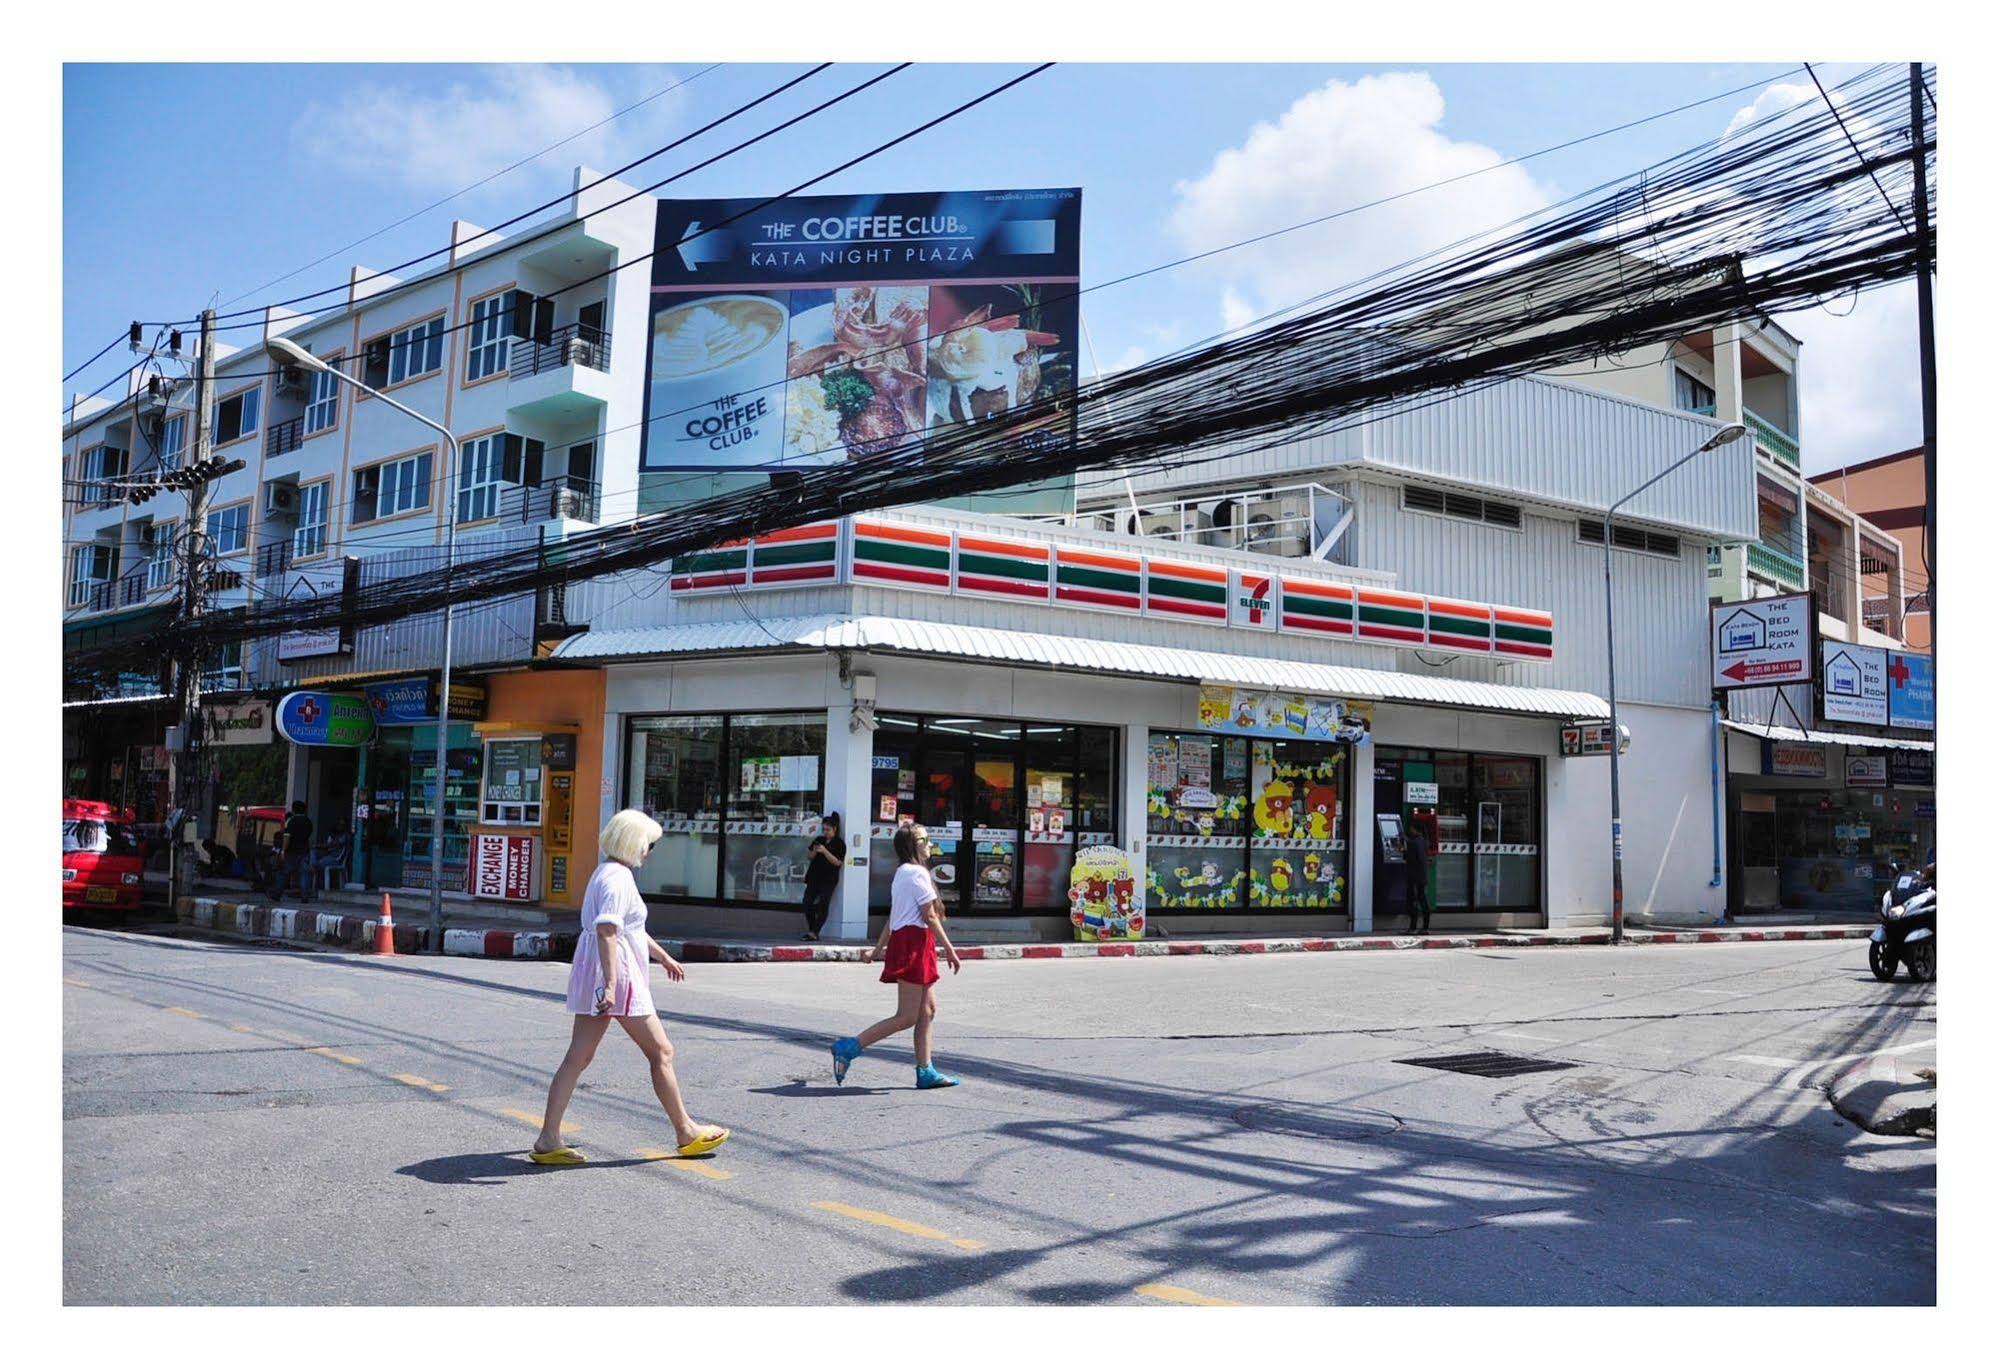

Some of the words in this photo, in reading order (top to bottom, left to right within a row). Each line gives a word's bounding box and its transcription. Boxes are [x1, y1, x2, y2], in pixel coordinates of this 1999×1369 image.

[762, 223, 796, 240] THE
[802, 215, 903, 241] COFFEE
[751, 252, 806, 266] KATA
[820, 249, 892, 264] NIGHT
[905, 246, 975, 262] PLAZA
[713, 394, 739, 411] THE
[686, 396, 768, 437] COFFEE
[320, 581, 336, 590] THE
[1241, 575, 1270, 624] 7
[1768, 603, 1788, 612] THE
[1768, 616, 1790, 626] BED
[1768, 629, 1799, 639] ROOM
[1768, 641, 1796, 651] KATA
[1864, 662, 1879, 671] THE
[1864, 675, 1880, 684] BED
[1864, 690, 1886, 698] ROOM
[481, 837, 503, 895] EXCHANGE
[508, 846, 519, 889] MONEY
[519, 839, 530, 898] CHANGER
